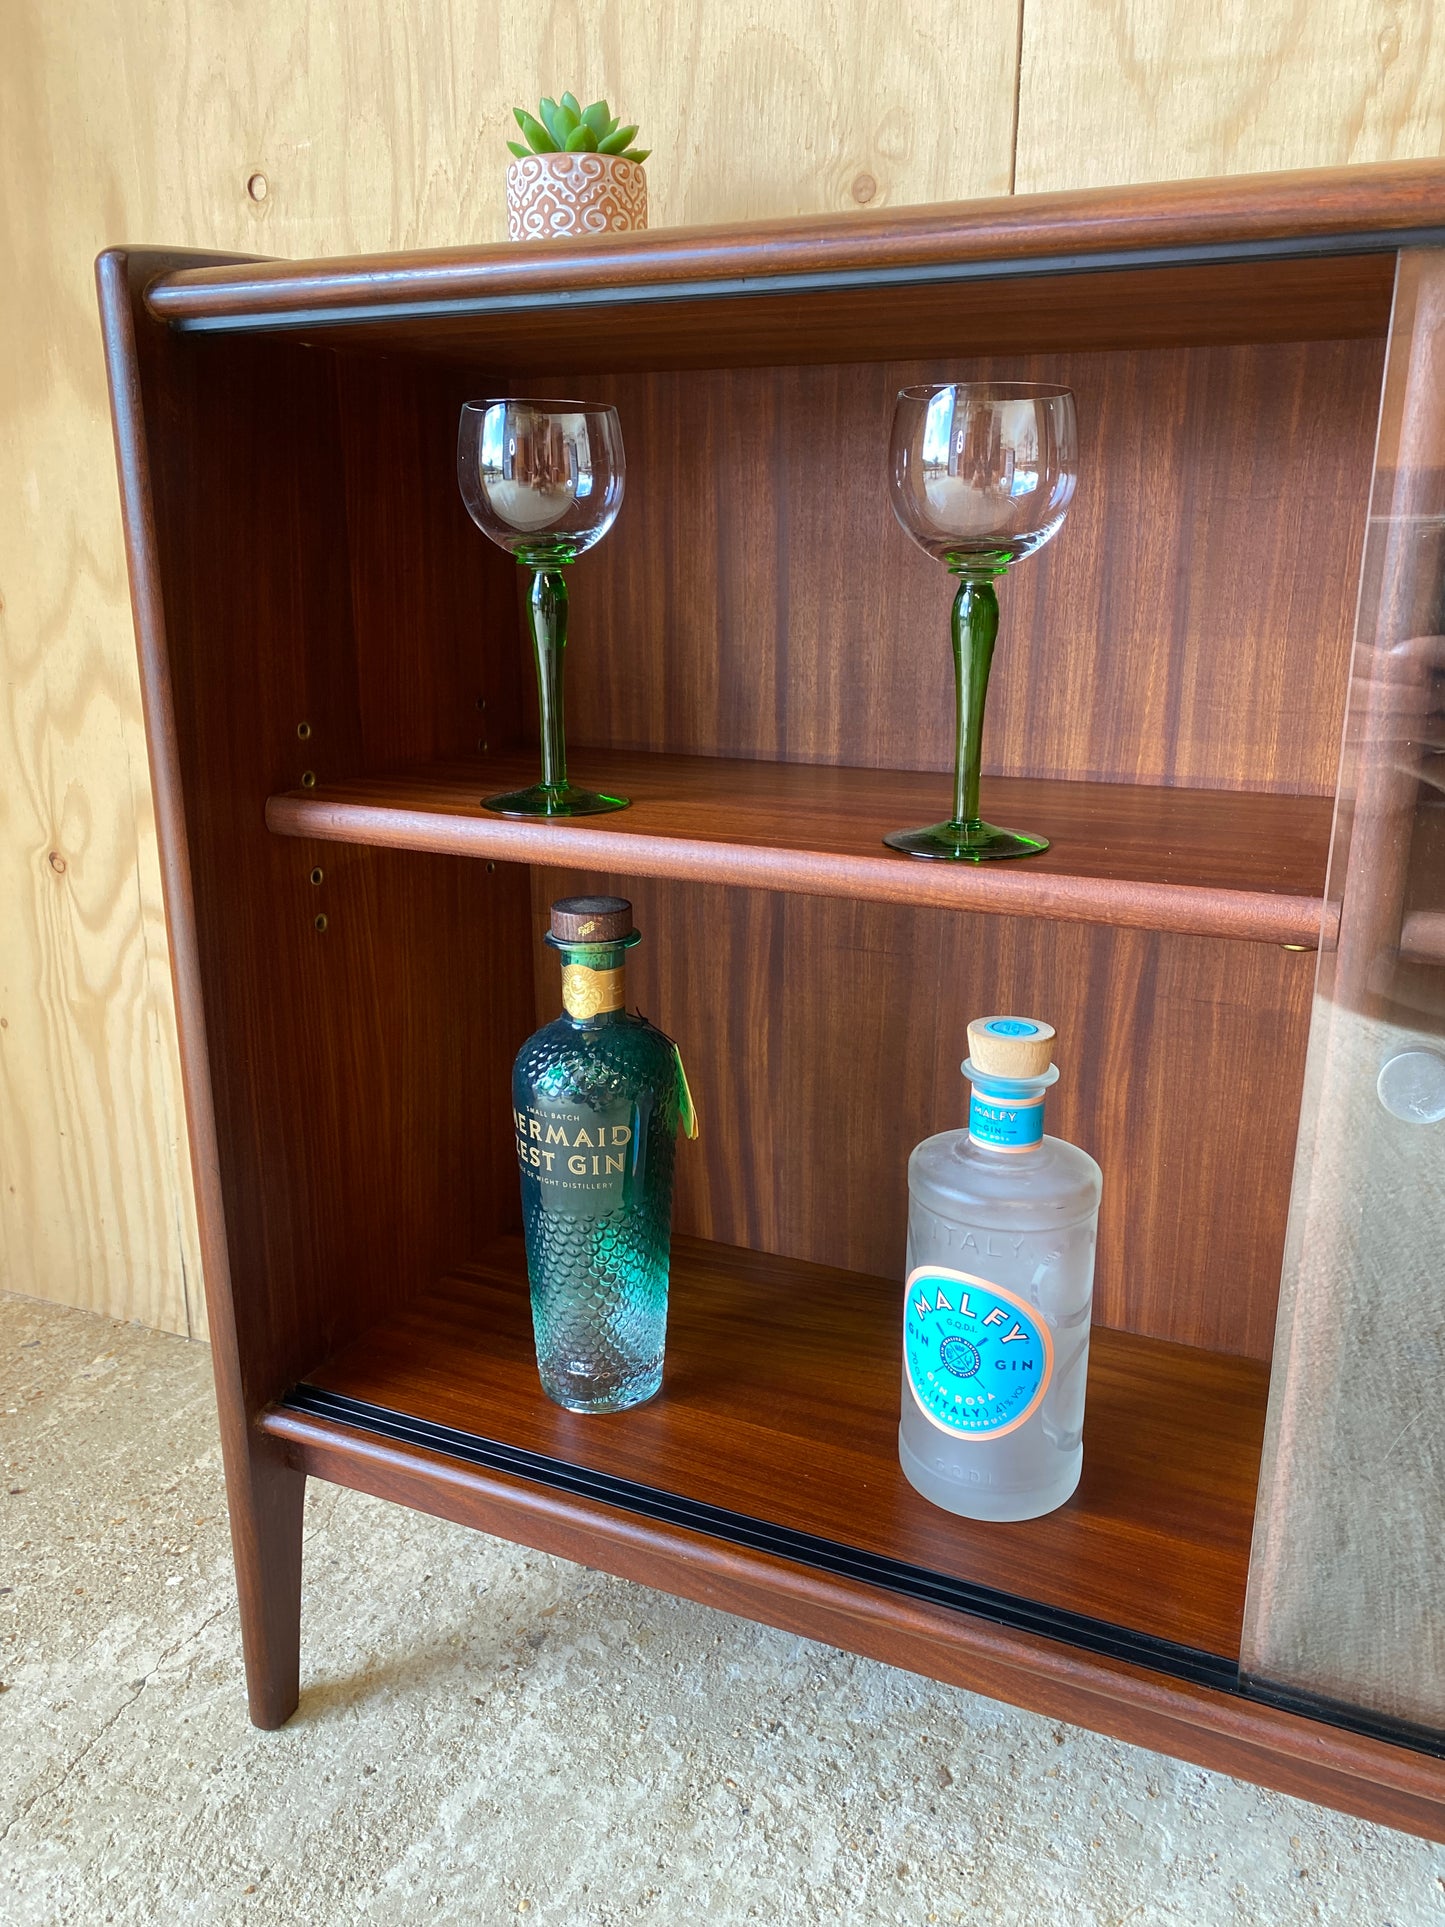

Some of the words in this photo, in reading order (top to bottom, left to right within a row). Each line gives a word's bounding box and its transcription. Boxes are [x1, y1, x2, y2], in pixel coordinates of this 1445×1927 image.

[526, 1105, 548, 1118] SMALL
[551, 1112, 580, 1121] BATCH
[974, 1106, 1017, 1122] MALFY
[983, 1125, 1002, 1134] GIN
[567, 1153, 625, 1176] GIN
[536, 1175, 560, 1187] WIGHT
[562, 1181, 614, 1190] DISTILLERY
[931, 1218, 1025, 1258] ITALY
[912, 1286, 1030, 1345] MALFY
[908, 1322, 929, 1347] GIN
[995, 1359, 1033, 1371] GIN
[926, 1371, 948, 1396] GIN
[954, 1392, 996, 1406] ROSA
[996, 1399, 1014, 1413] 41%
[1011, 1385, 1026, 1399] VOL
[929, 1390, 989, 1418] (ITALY)
[939, 1411, 1008, 1427] GRAPEFRUIT
